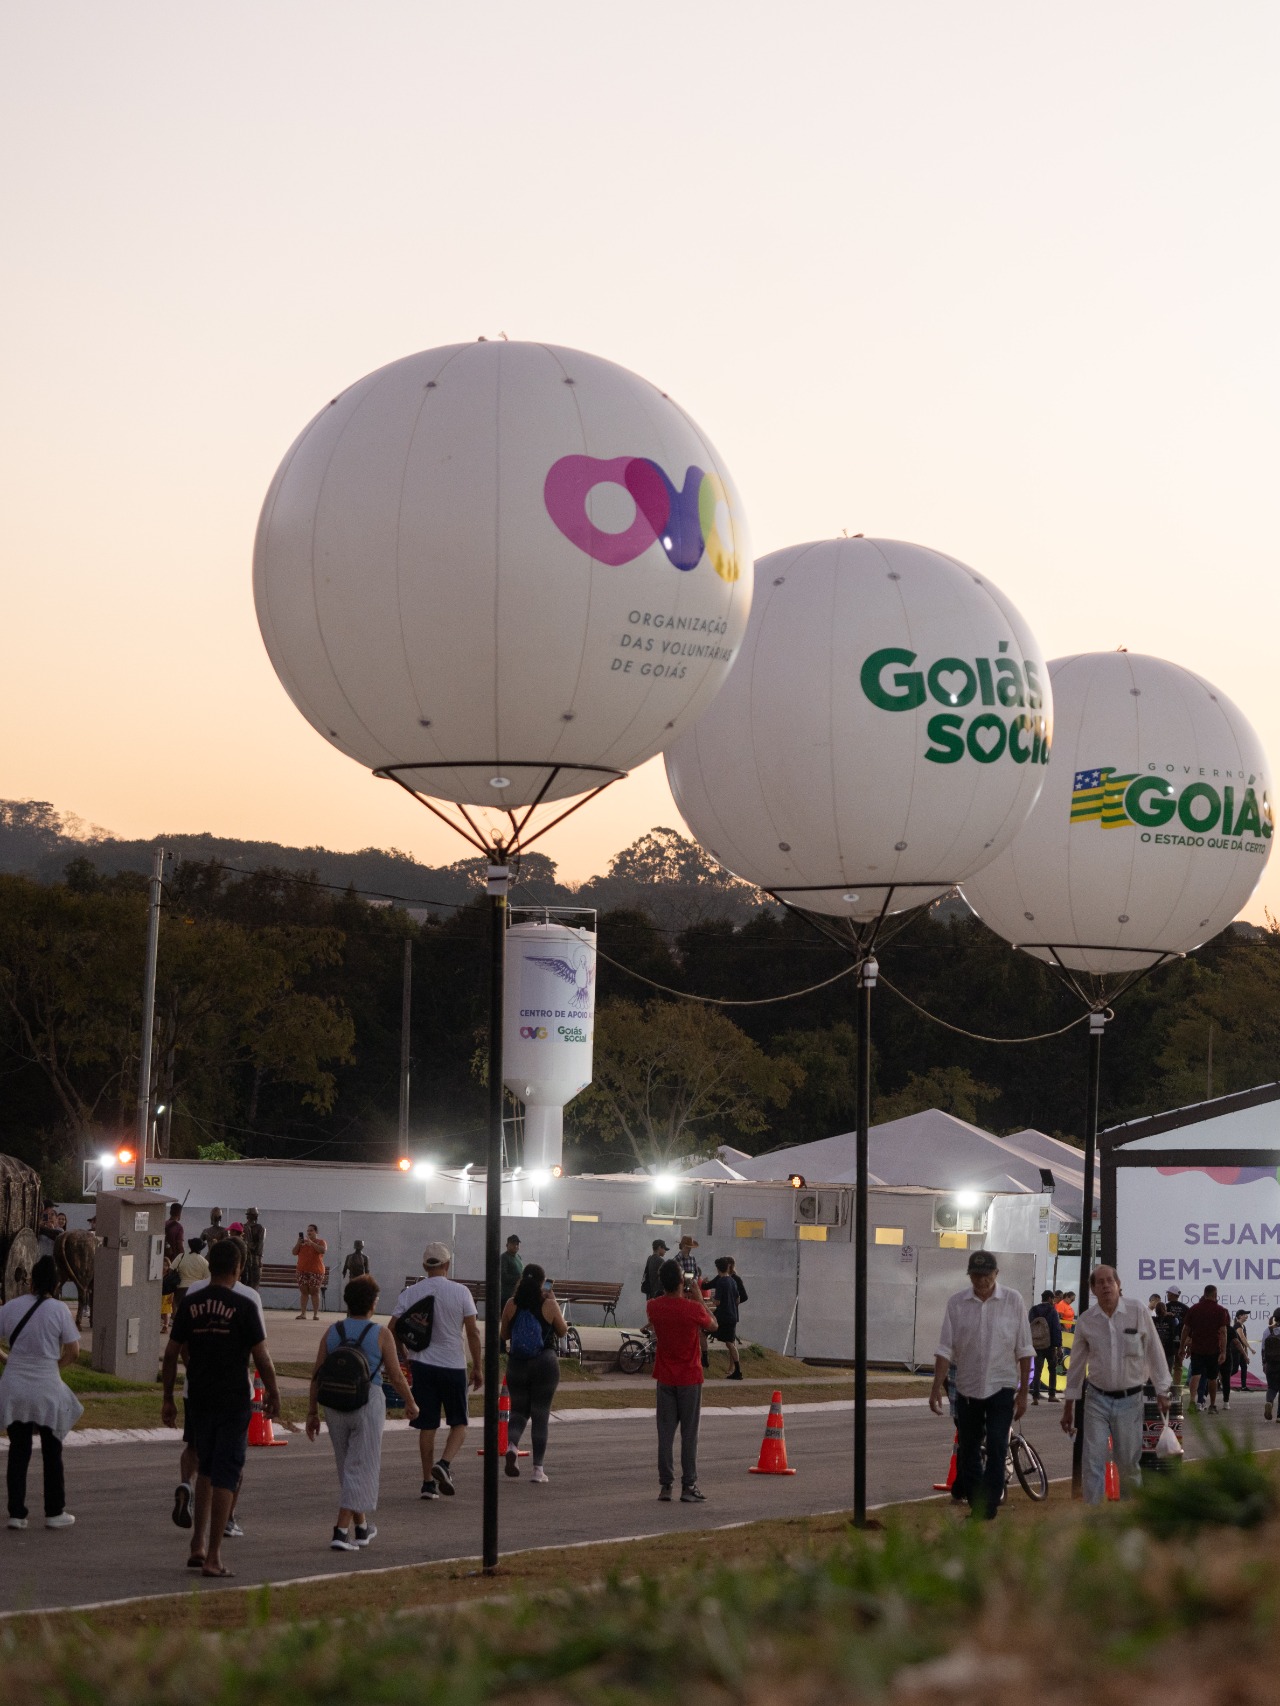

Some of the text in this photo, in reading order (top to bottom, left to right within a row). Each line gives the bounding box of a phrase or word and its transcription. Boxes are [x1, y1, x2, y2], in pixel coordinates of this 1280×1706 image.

[628, 610, 728, 636] ORGANIZAÇÃO
[620, 634, 654, 651] DAS
[611, 658, 687, 679] DE GOIÁS
[1148, 763, 1244, 778] GOVERNO
[1140, 832, 1151, 843] O
[1155, 834, 1204, 847] ESTADO
[1207, 838, 1228, 849] QUE
[1245, 842, 1266, 854] CERTO
[520, 1009, 553, 1018] CENTRO
[555, 1010, 566, 1018] DE
[568, 1010, 588, 1019] APOIO
[117, 1176, 160, 1186] CEAR
